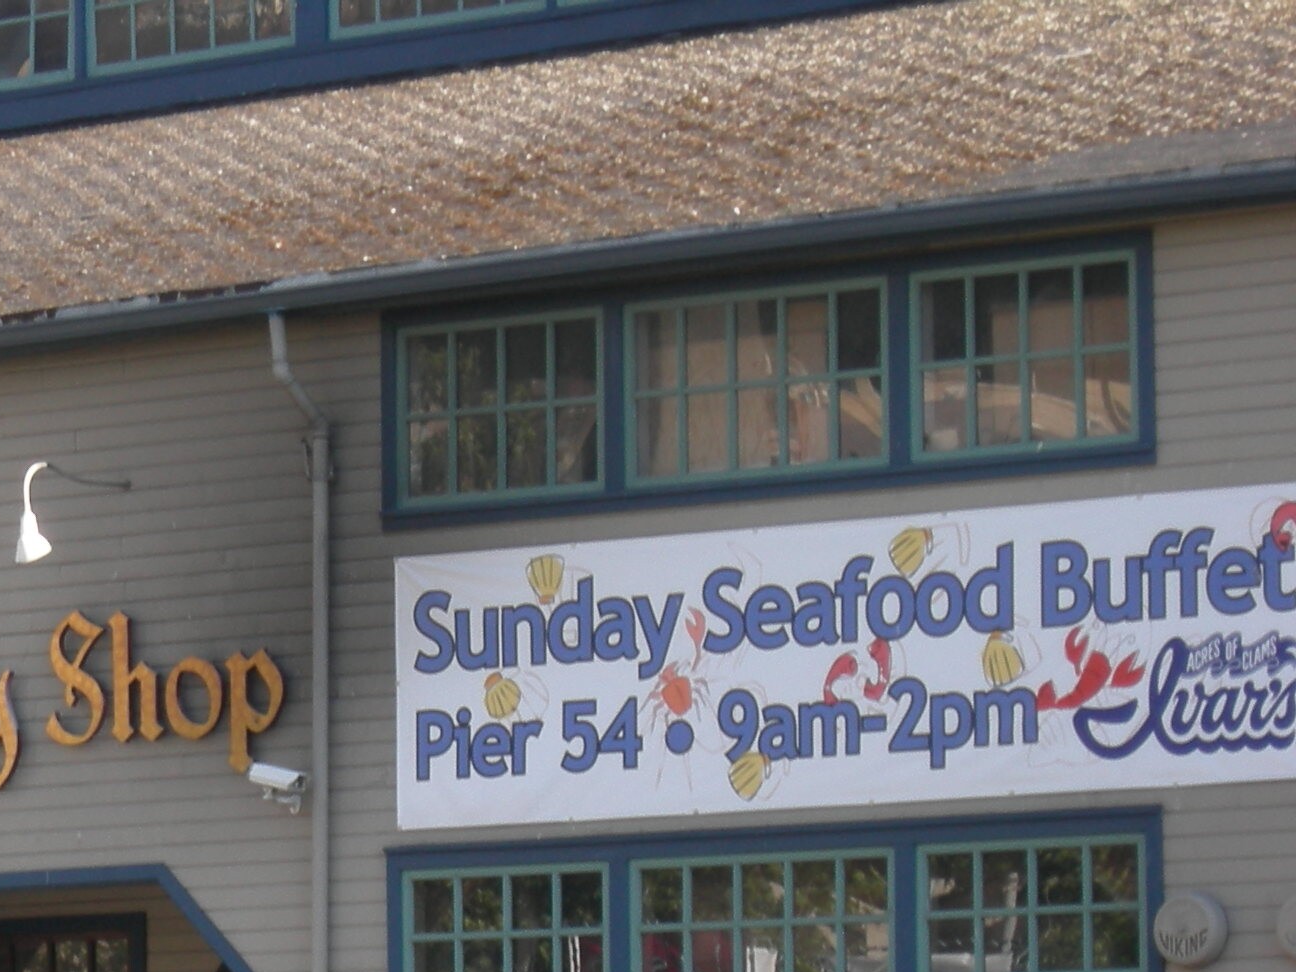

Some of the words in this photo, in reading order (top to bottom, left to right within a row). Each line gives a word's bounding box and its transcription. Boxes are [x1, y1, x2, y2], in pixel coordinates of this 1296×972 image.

[413, 577, 684, 679] Sunday
[702, 541, 1017, 653] Seafood
[1039, 527, 1296, 630] Buffet
[46, 609, 284, 774] Shop
[1186, 635, 1221, 673] ACRES
[1225, 637, 1239, 661] OF
[1242, 634, 1278, 672] CLAMS
[415, 707, 543, 782] Pier
[560, 695, 642, 774] 54
[1158, 928, 1209, 958] VIKING
